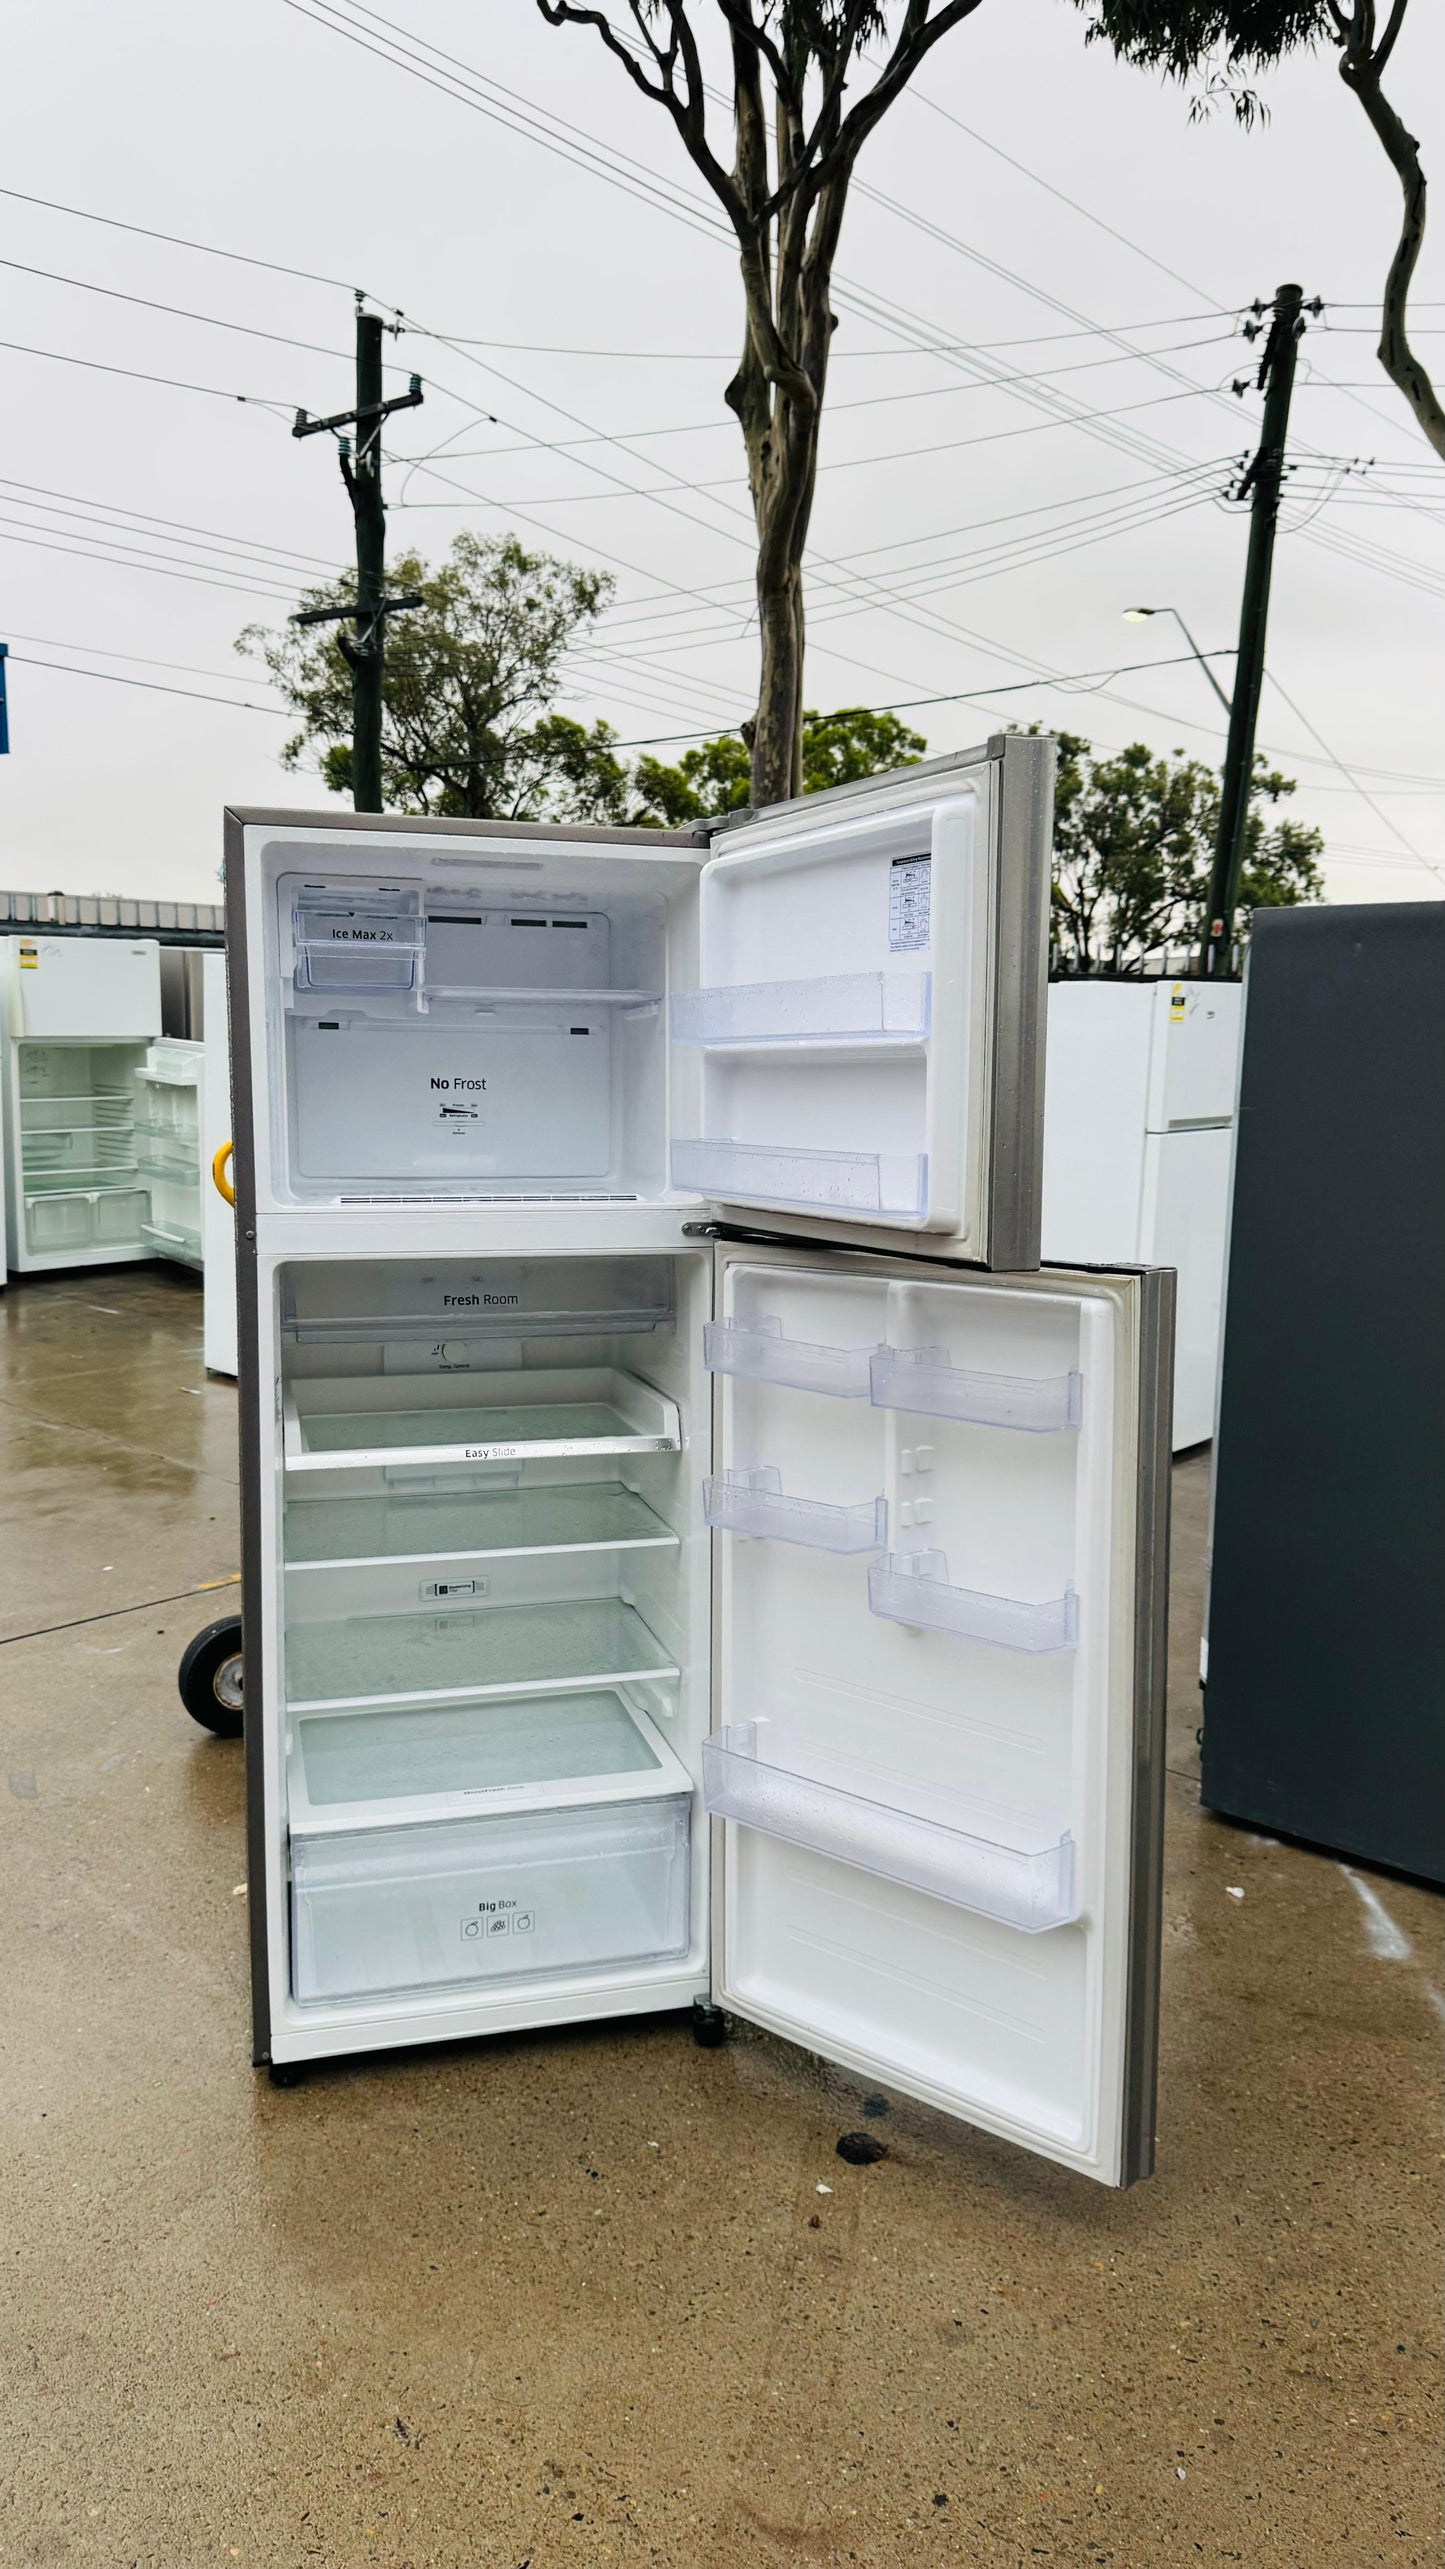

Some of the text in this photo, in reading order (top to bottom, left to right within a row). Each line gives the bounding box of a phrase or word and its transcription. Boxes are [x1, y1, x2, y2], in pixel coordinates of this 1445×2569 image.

[332, 929, 393, 941] Ice Max 2x
[431, 1077, 487, 1090] No Frost
[444, 1294, 519, 1305] Fresh Room
[465, 1447, 516, 1460] Easy Slide
[479, 1899, 518, 1912] Big Box
